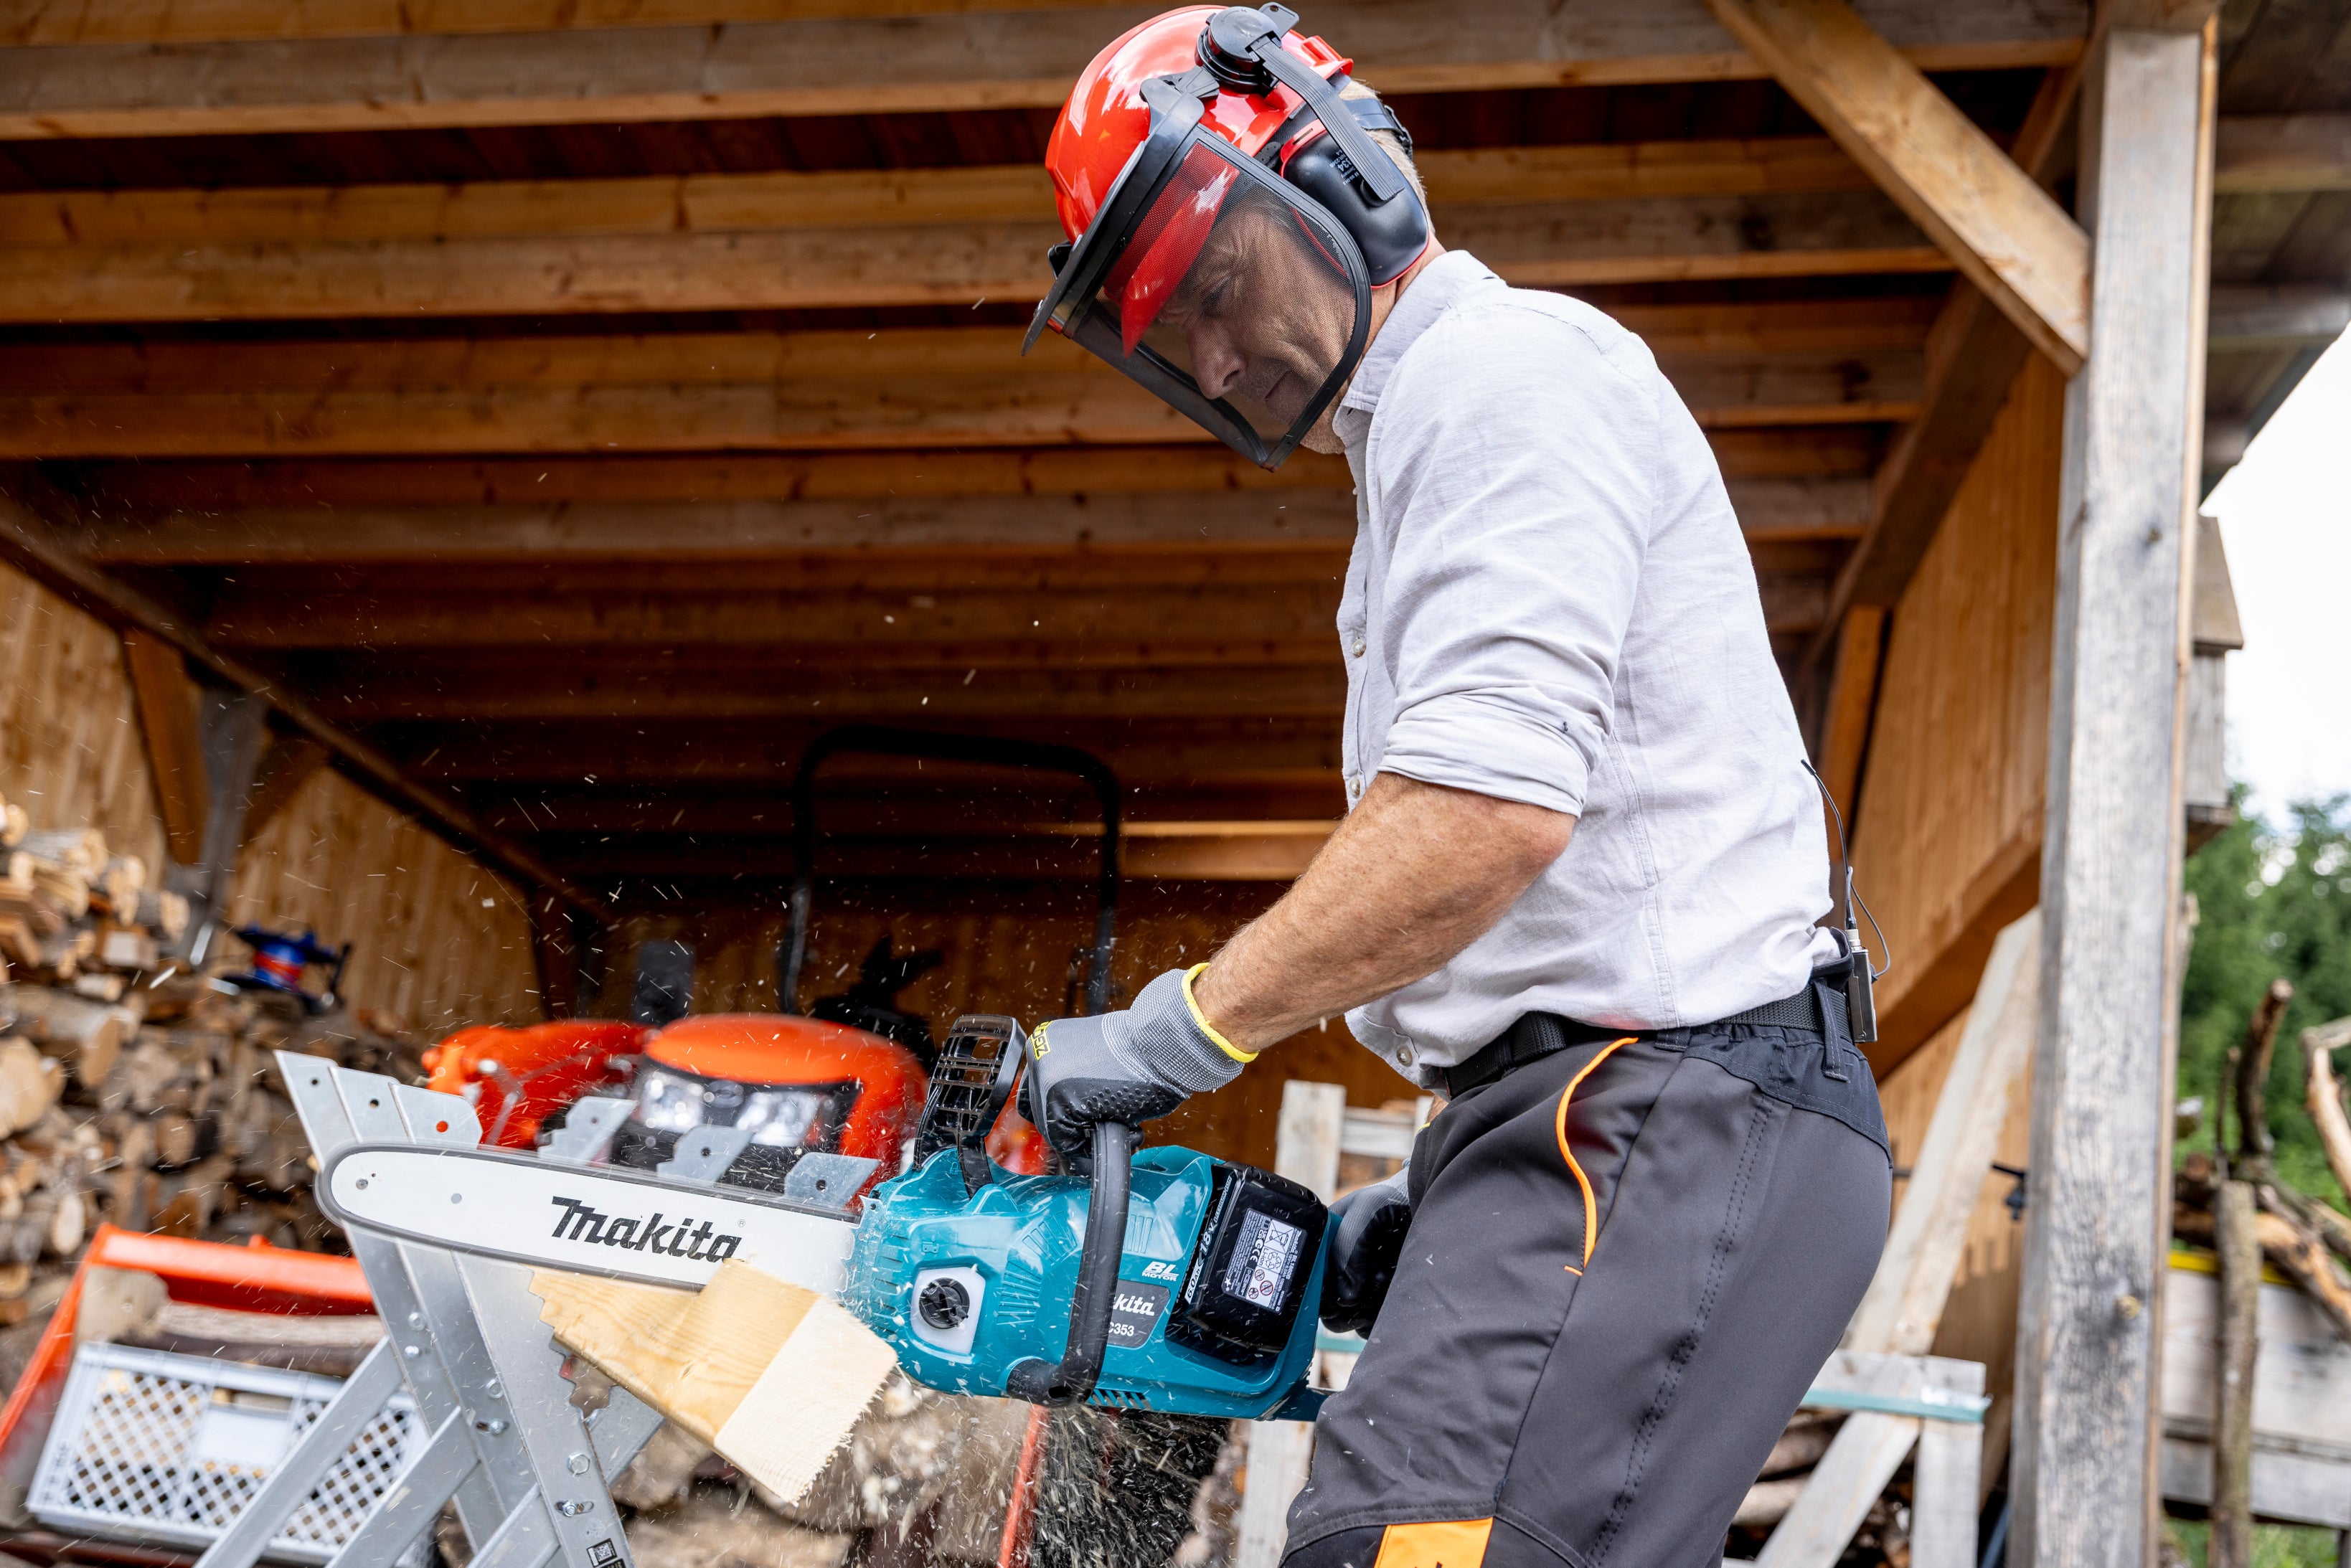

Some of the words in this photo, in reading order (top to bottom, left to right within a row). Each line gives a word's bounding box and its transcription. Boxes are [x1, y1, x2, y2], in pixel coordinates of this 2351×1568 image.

[552, 1196, 742, 1263] Makita
[1258, 1247, 1269, 1266] Li-ion
[1141, 1272, 1177, 1282] MOTOR
[1143, 1261, 1179, 1277] BL
